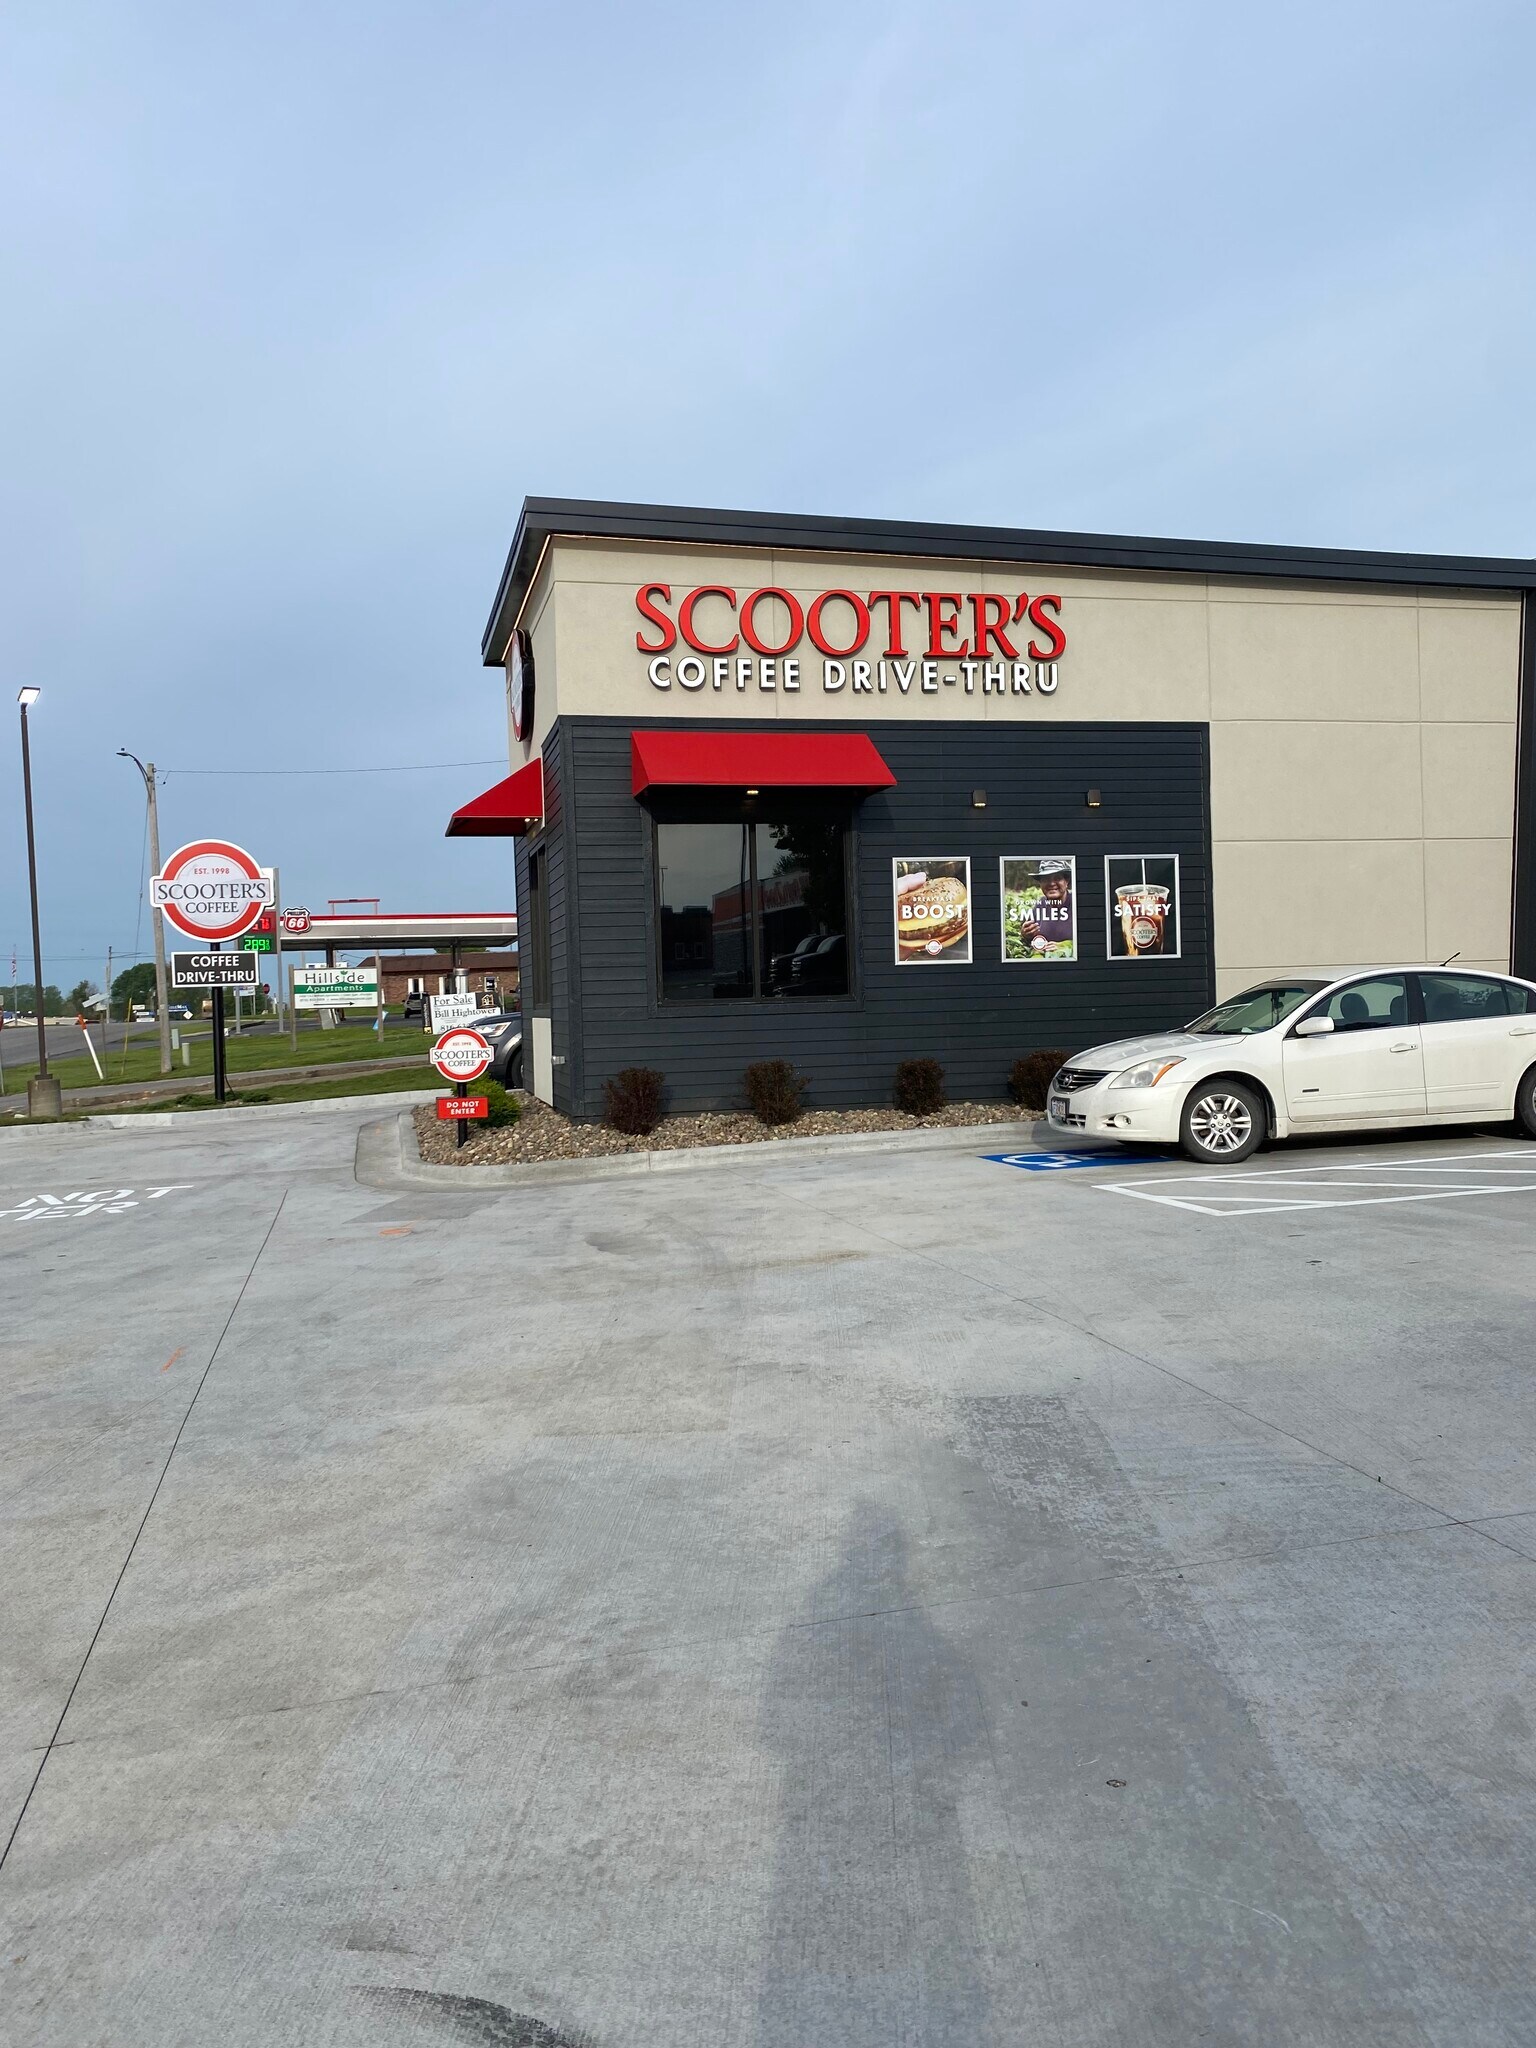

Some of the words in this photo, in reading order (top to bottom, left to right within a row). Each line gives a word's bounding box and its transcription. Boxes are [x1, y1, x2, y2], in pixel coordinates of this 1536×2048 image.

[636, 583, 1067, 660] SCOOTER'S
[648, 656, 800, 690] COFFEE
[823, 660, 1059, 693] DRIVE-THRU
[212, 867, 230, 875] 1998
[158, 882, 267, 900] SCOOTER'S
[185, 901, 239, 914] COFFEE
[902, 904, 965, 919] BOOST
[1009, 907, 1069, 921] SMILES
[1114, 904, 1172, 917] SATISFY
[288, 918, 305, 929] 66
[191, 955, 239, 968] COFFEE
[177, 970, 254, 984] DRIVE-THRU
[305, 972, 365, 984] Hillside
[306, 985, 364, 993] Apartments
[434, 996, 451, 1005] For
[453, 994, 473, 1004] Sale
[435, 1009, 450, 1019] Bill
[452, 1008, 497, 1018] Hightower
[434, 1050, 491, 1060] SCOOTER'S
[446, 1101, 458, 1109] DO
[14, 1185, 195, 1209] NOT
